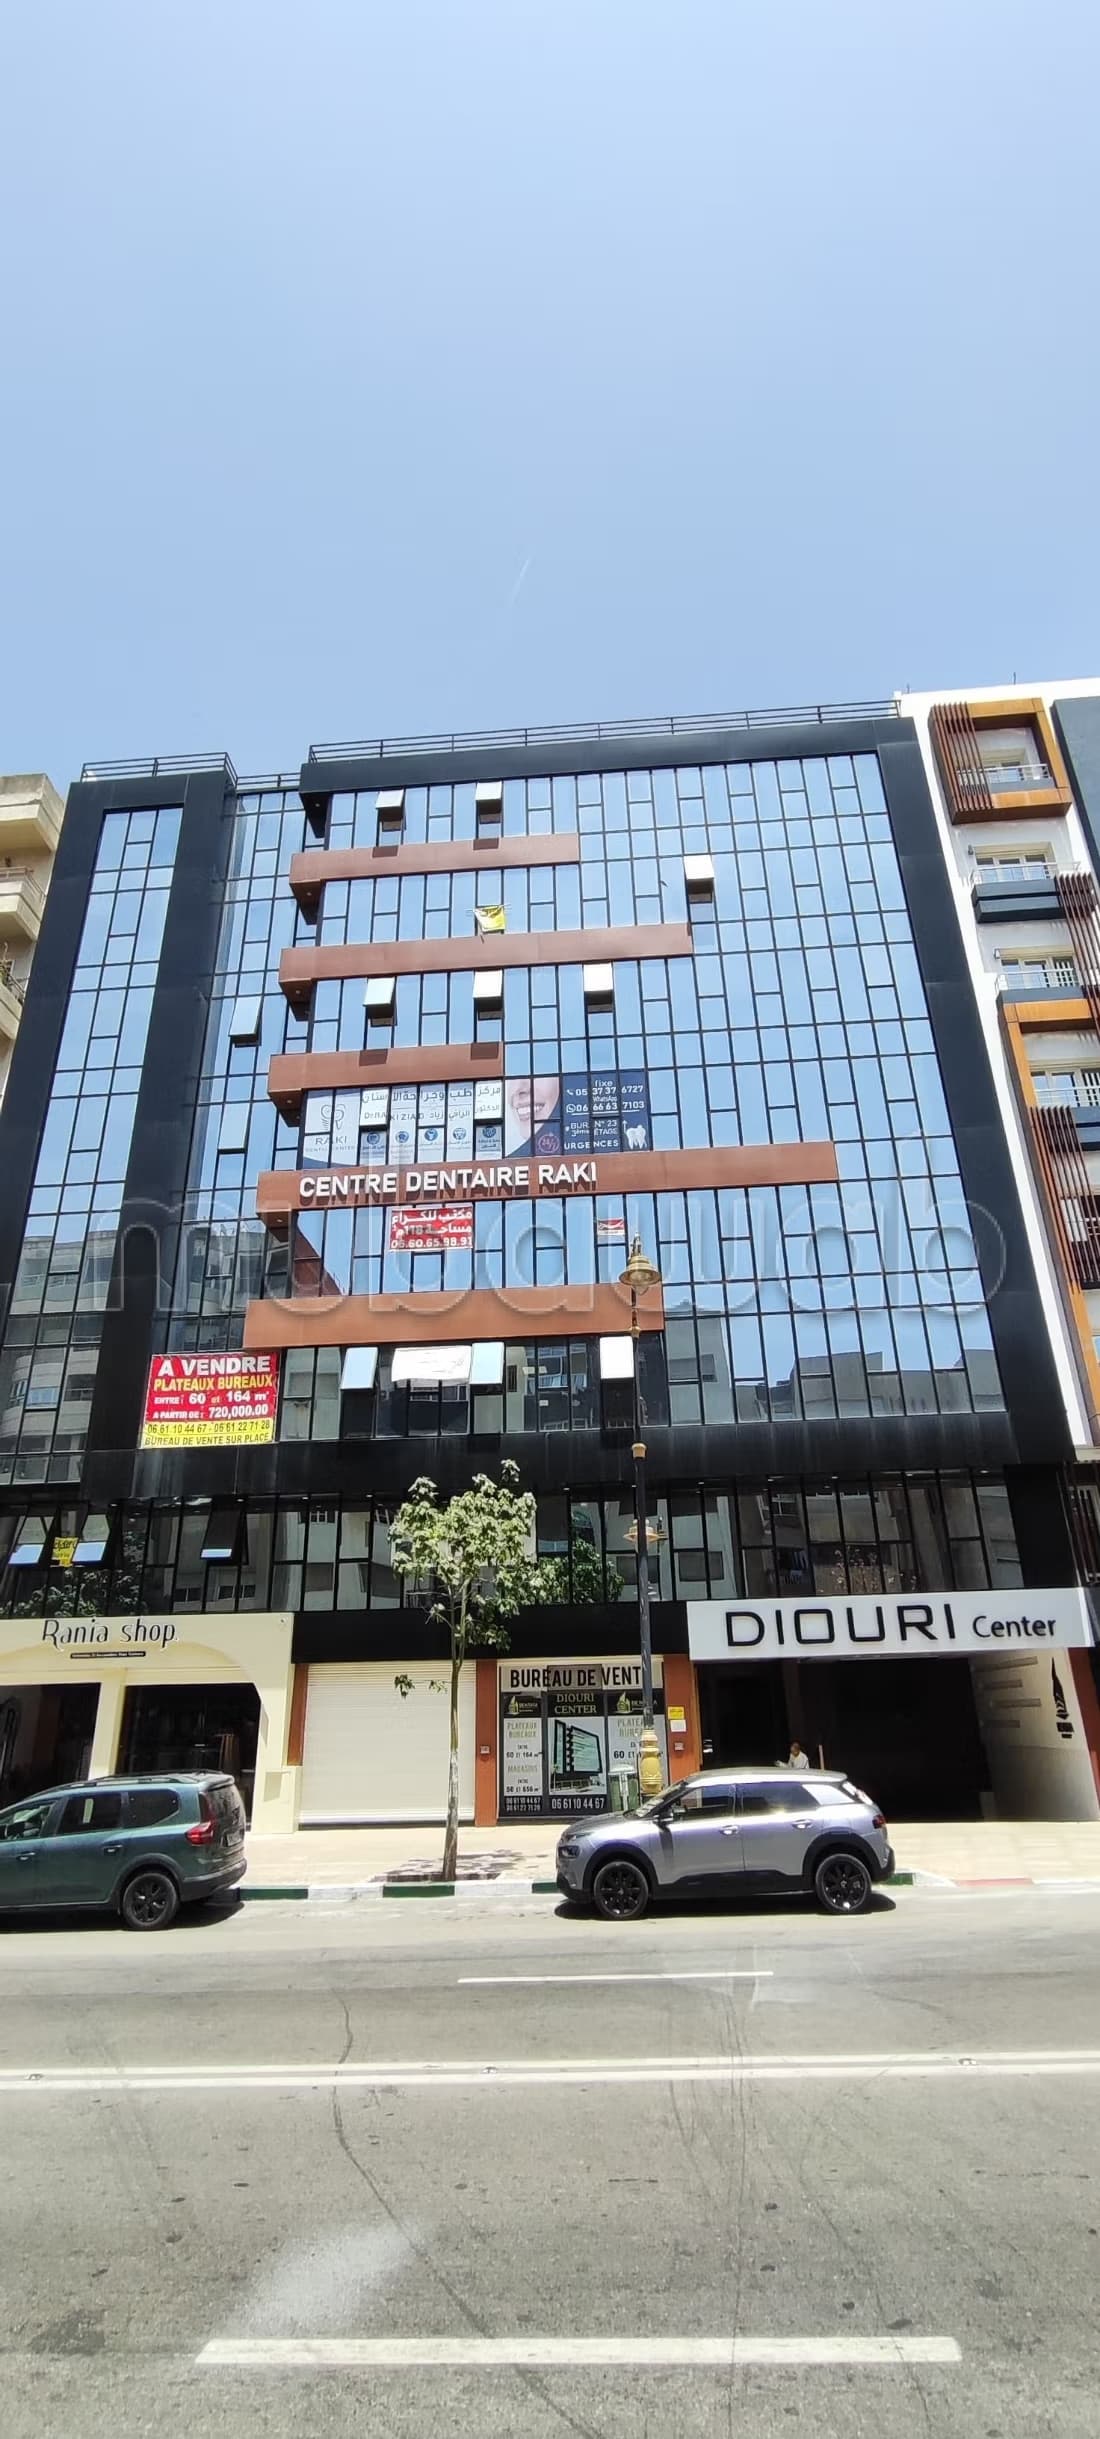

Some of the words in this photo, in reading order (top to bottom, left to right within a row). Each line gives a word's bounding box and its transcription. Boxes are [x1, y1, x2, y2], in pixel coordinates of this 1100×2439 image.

[575, 1088, 588, 1096] 05
[592, 1087, 603, 1095] 37
[605, 1086, 617, 1094] 37
[621, 1085, 644, 1094] 6727
[576, 1104, 588, 1112] 06
[593, 1103, 604, 1111] 66
[606, 1102, 618, 1110] 63
[622, 1101, 645, 1109] 7103
[607, 1119, 617, 1127] 23
[564, 1139, 619, 1150] URGENCES
[299, 1171, 398, 1198] CENTRE
[405, 1165, 529, 1192] DENTAIRE
[538, 1162, 597, 1185] RAKI
[438, 1208, 473, 1222] مكتب
[181, 1356, 271, 1376] VENDRE
[154, 1377, 215, 1391] PLATEAUX
[217, 1374, 273, 1389] BUREAUX
[189, 1392, 206, 1405] 60
[226, 1390, 251, 1402] 164
[208, 1404, 268, 1419] 720,000.00
[147, 1424, 158, 1434] 06
[159, 1424, 169, 1433] 61
[184, 1423, 195, 1433] 44
[197, 1423, 207, 1433] 67
[238, 1421, 248, 1431] 22
[145, 1436, 180, 1446] BUREAU
[182, 1436, 193, 1445] DE
[195, 1435, 224, 1445] VENTE
[226, 1434, 242, 1444] SUR
[245, 1433, 269, 1443] PLACE
[725, 1603, 956, 1648] DIOURI
[972, 1615, 1056, 1639] Center
[42, 1618, 109, 1649] Rania
[510, 1669, 572, 1688] BUREAU
[577, 1669, 596, 1686] DE
[556, 1693, 594, 1703] DIOURI
[554, 1704, 597, 1714] CENTER
[613, 1750, 625, 1759] 60
[563, 1798, 572, 1809] 61
[573, 1798, 582, 1809] 10
[583, 1797, 593, 1809] 44
